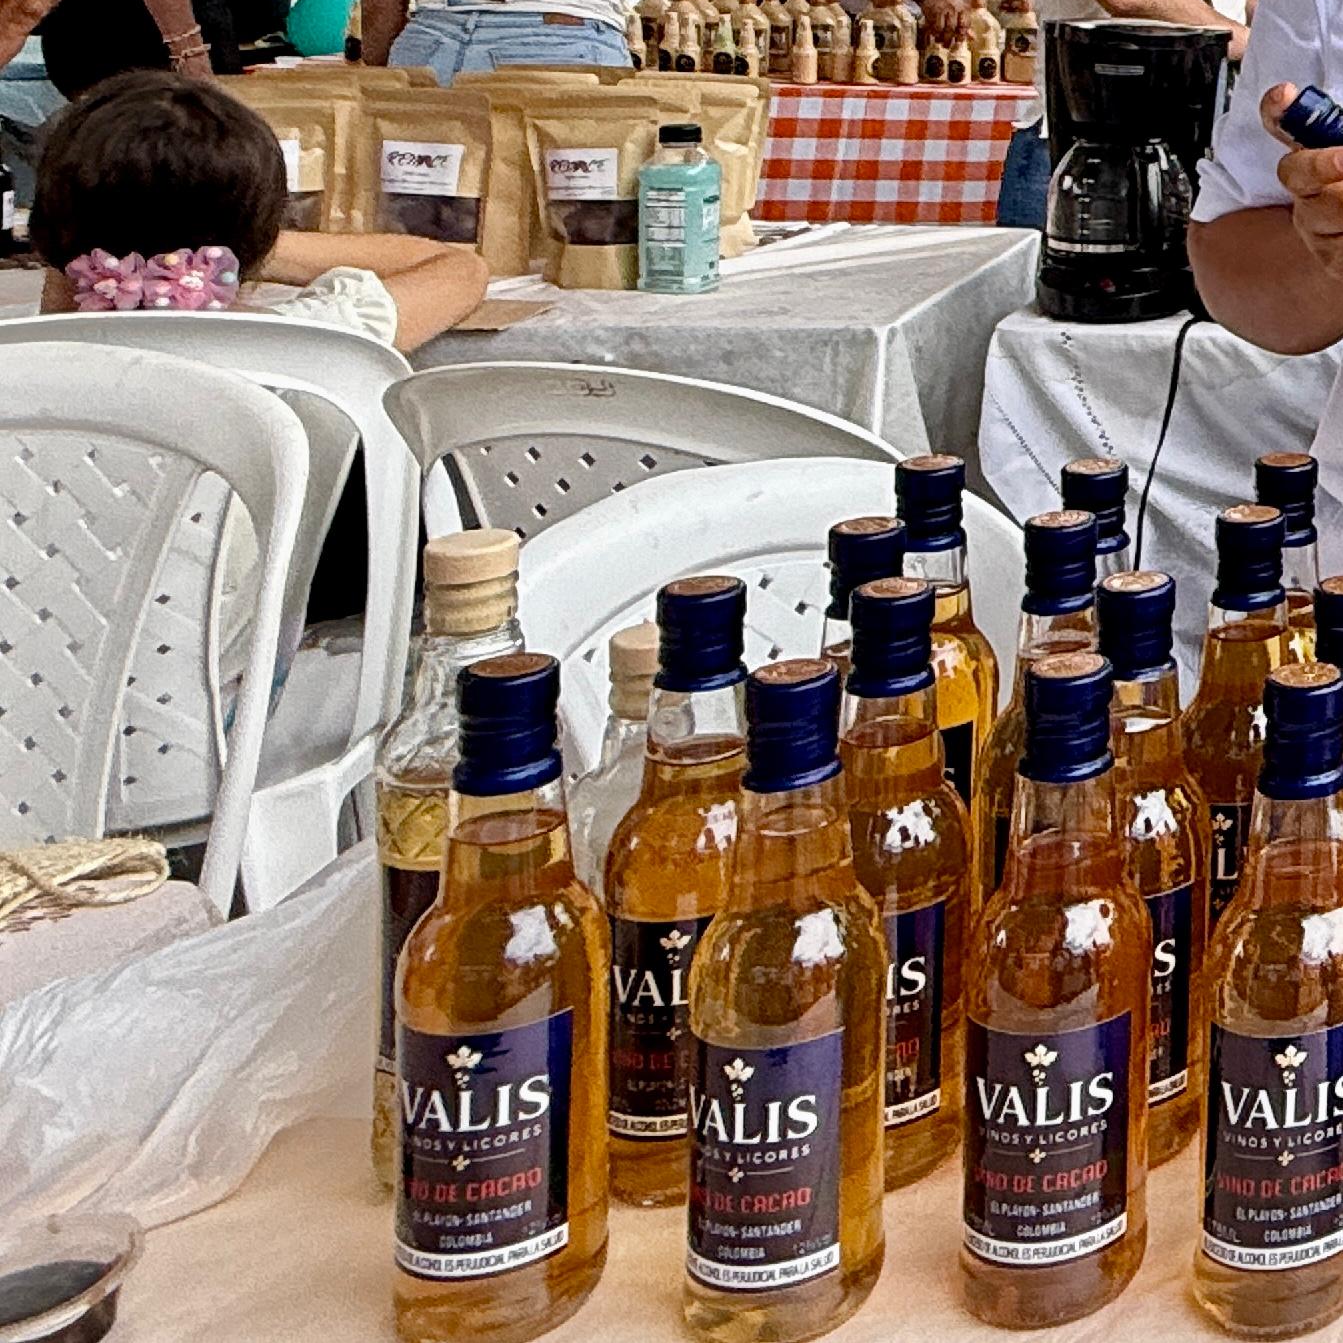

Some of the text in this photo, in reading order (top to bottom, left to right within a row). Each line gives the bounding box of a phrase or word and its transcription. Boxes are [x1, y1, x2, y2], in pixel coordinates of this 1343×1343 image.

[612, 964, 690, 1007] VAL
[402, 1072, 552, 1134] VALIS
[689, 1085, 819, 1145] VALIS
[976, 1071, 1114, 1127] VALIS
[462, 1122, 543, 1152] LICORES
[1025, 1135, 1034, 1146] Y
[1038, 1118, 1108, 1146] LICORES
[1222, 1129, 1269, 1149] VINOS
[1273, 1136, 1282, 1149] Y
[736, 1142, 812, 1165] LICORES
[466, 1166, 544, 1203] CACAO
[1012, 1175, 1037, 1194] DE
[1041, 1158, 1109, 1193] CACAO
[1260, 1178, 1284, 1201] DE
[740, 1186, 813, 1214] CACAO
